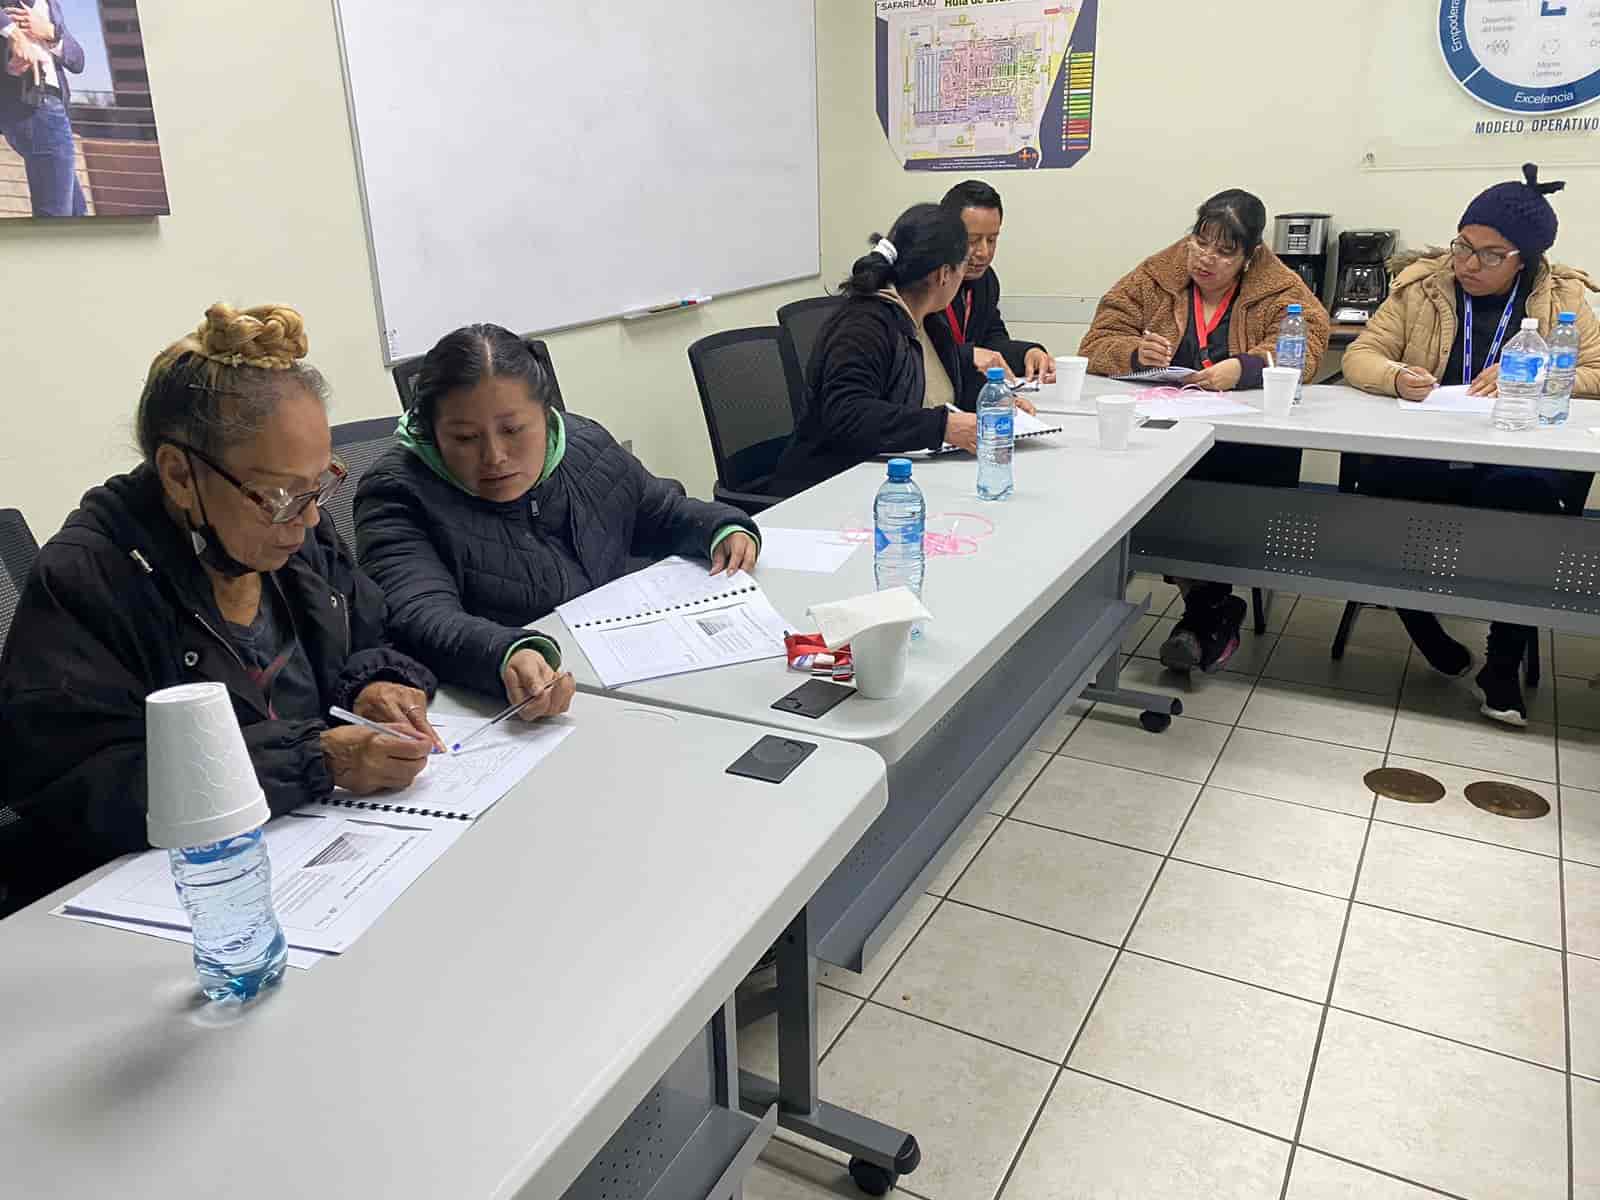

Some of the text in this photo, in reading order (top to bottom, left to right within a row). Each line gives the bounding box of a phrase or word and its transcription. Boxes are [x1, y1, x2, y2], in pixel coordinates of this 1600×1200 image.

[1514, 91, 1574, 104] Excelencia
[1475, 117, 1600, 134] MODELO OPERATIVO
